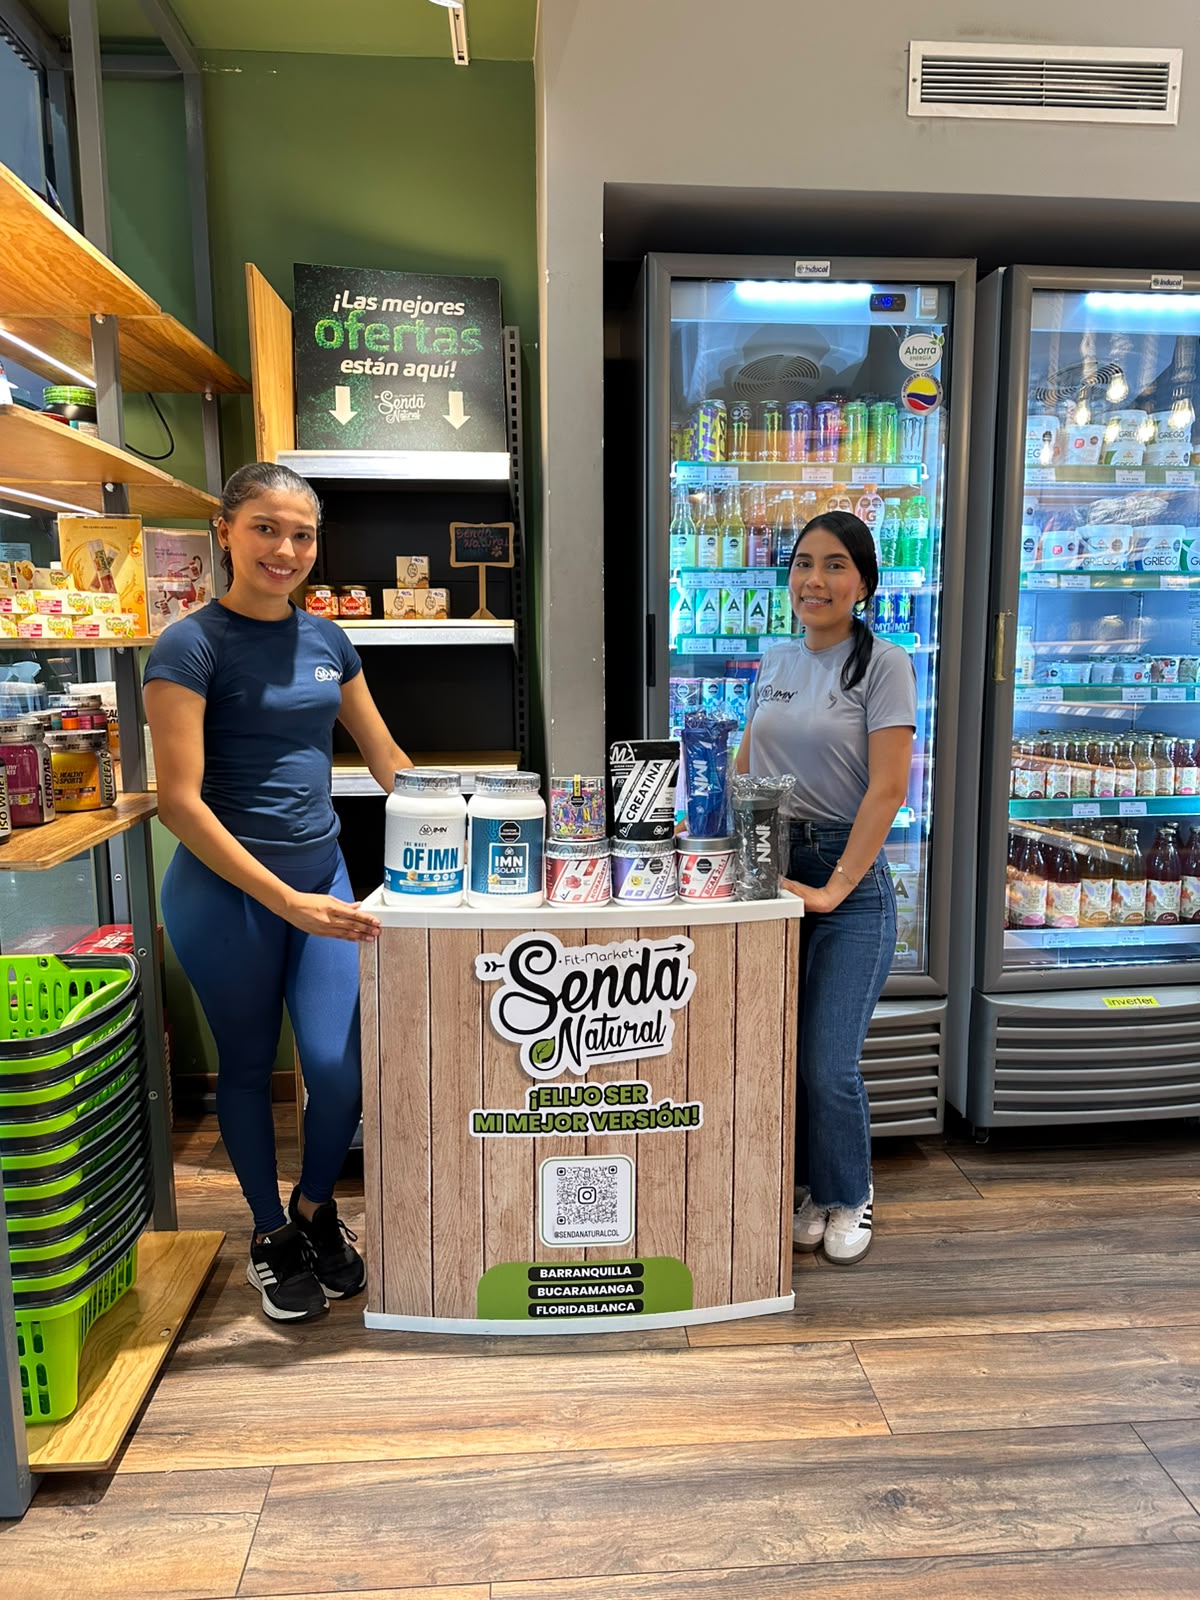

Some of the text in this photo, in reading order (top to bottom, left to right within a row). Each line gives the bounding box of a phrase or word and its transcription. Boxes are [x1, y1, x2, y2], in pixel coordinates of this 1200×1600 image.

[332, 290, 465, 319] ¡Las mejores
[314, 309, 485, 356] ofertas
[904, 346, 937, 356] Ahorra
[340, 356, 458, 383] están aquí!
[377, 390, 427, 415] Senda
[60, 777, 83, 785] SPORTS
[101, 751, 115, 801] NUCLEAR
[692, 759, 709, 797] IMN
[626, 762, 664, 821] CREATINA
[0, 808, 9, 831] ISO
[755, 824, 771, 863] IMN
[403, 847, 459, 871] OF IMN
[495, 855, 524, 867] IMN
[704, 876, 718, 895] BCAA
[498, 939, 689, 1035] Senda
[529, 1009, 667, 1072] Natural
[529, 1084, 649, 1111] ¡ELIJO SER
[473, 1102, 701, 1134] MI MEJOR VERSIÓN!
[553, 1229, 620, 1240] @SENDANATURALCOL
[539, 1265, 632, 1279] BARRANQUILLA
[537, 1283, 635, 1297] BUCARAMANGA
[535, 1301, 636, 1316] FLORIDABLANCA
